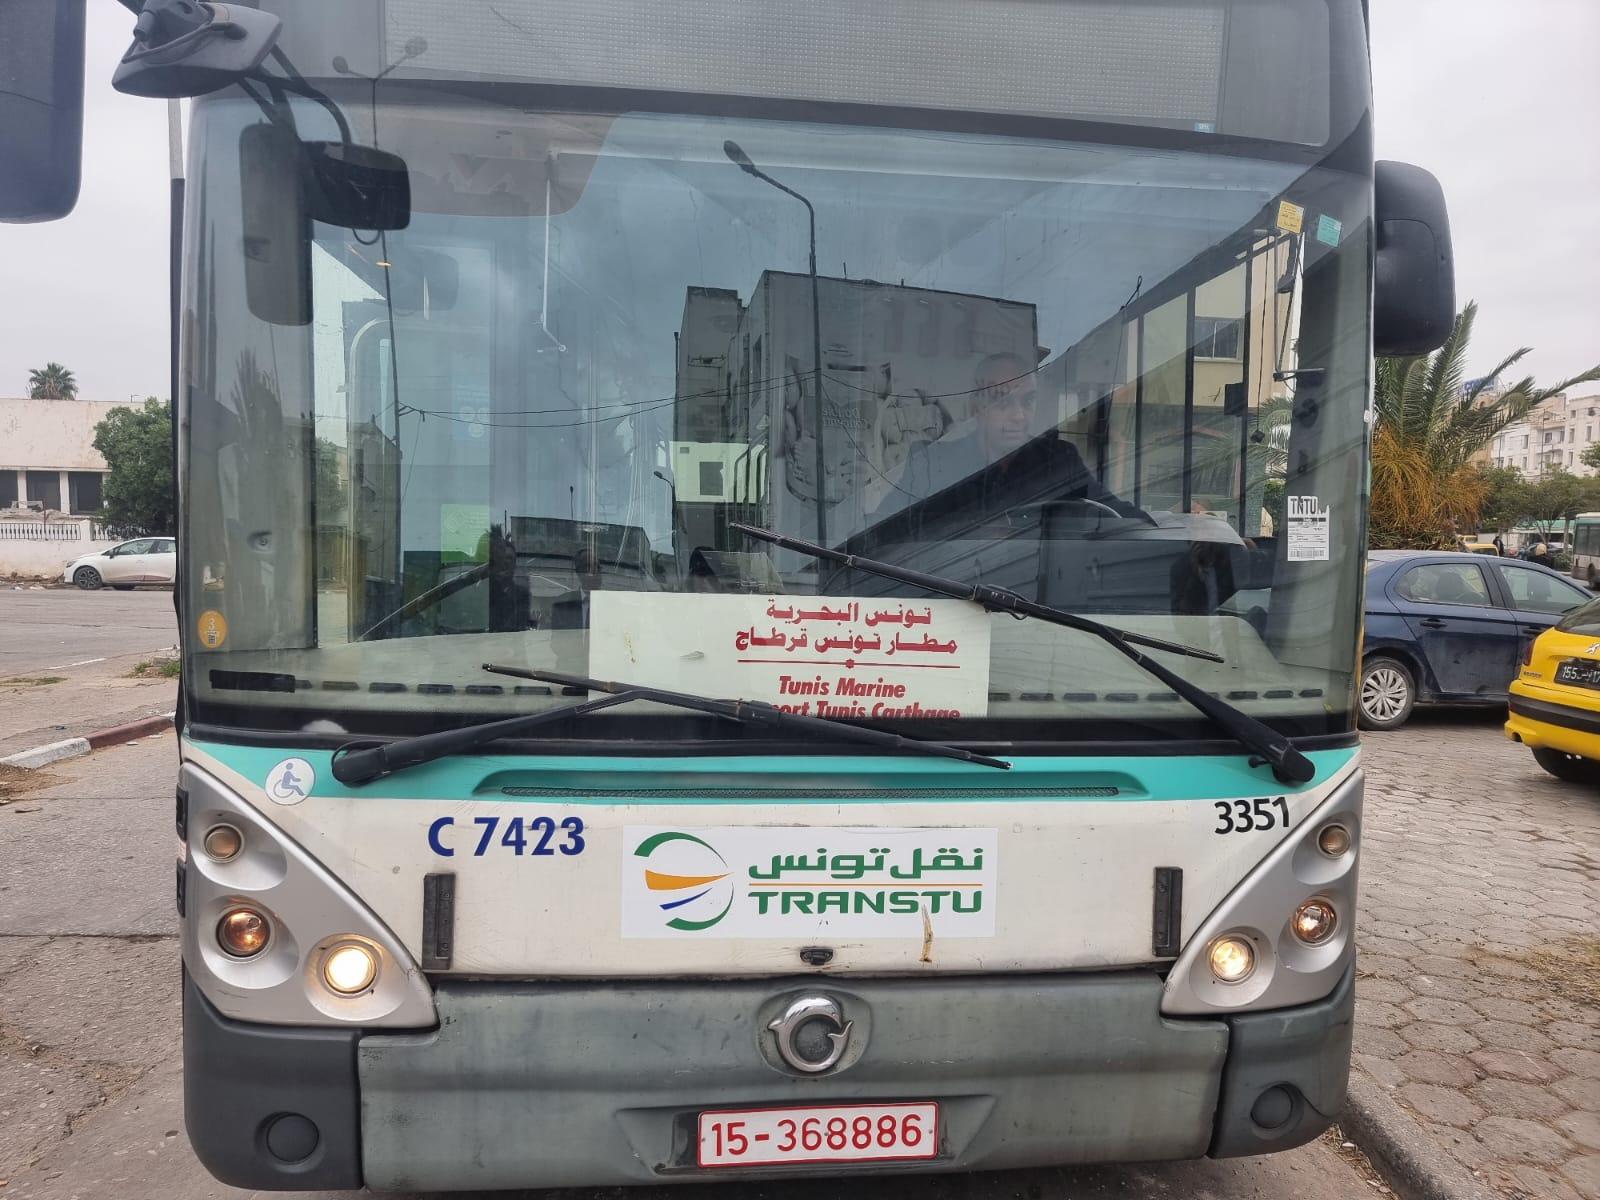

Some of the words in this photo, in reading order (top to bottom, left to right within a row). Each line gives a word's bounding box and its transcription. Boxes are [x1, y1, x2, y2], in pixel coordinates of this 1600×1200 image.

[766, 598, 859, 627] البحرية
[865, 604, 932, 628] تونس
[735, 626, 808, 652] قرطاج
[814, 629, 881, 654] تونس
[885, 631, 958, 655] مطار
[779, 675, 830, 696] Tunis
[835, 677, 906, 698] Marine
[815, 700, 866, 718] Tunis
[1214, 796, 1290, 834] 3351
[428, 816, 454, 857] C
[475, 816, 586, 857] 7423
[748, 847, 890, 880] تونس
[890, 847, 984, 880] نقل
[748, 890, 984, 915] TRANSTU
[711, 1113, 923, 1158] 15-368886
